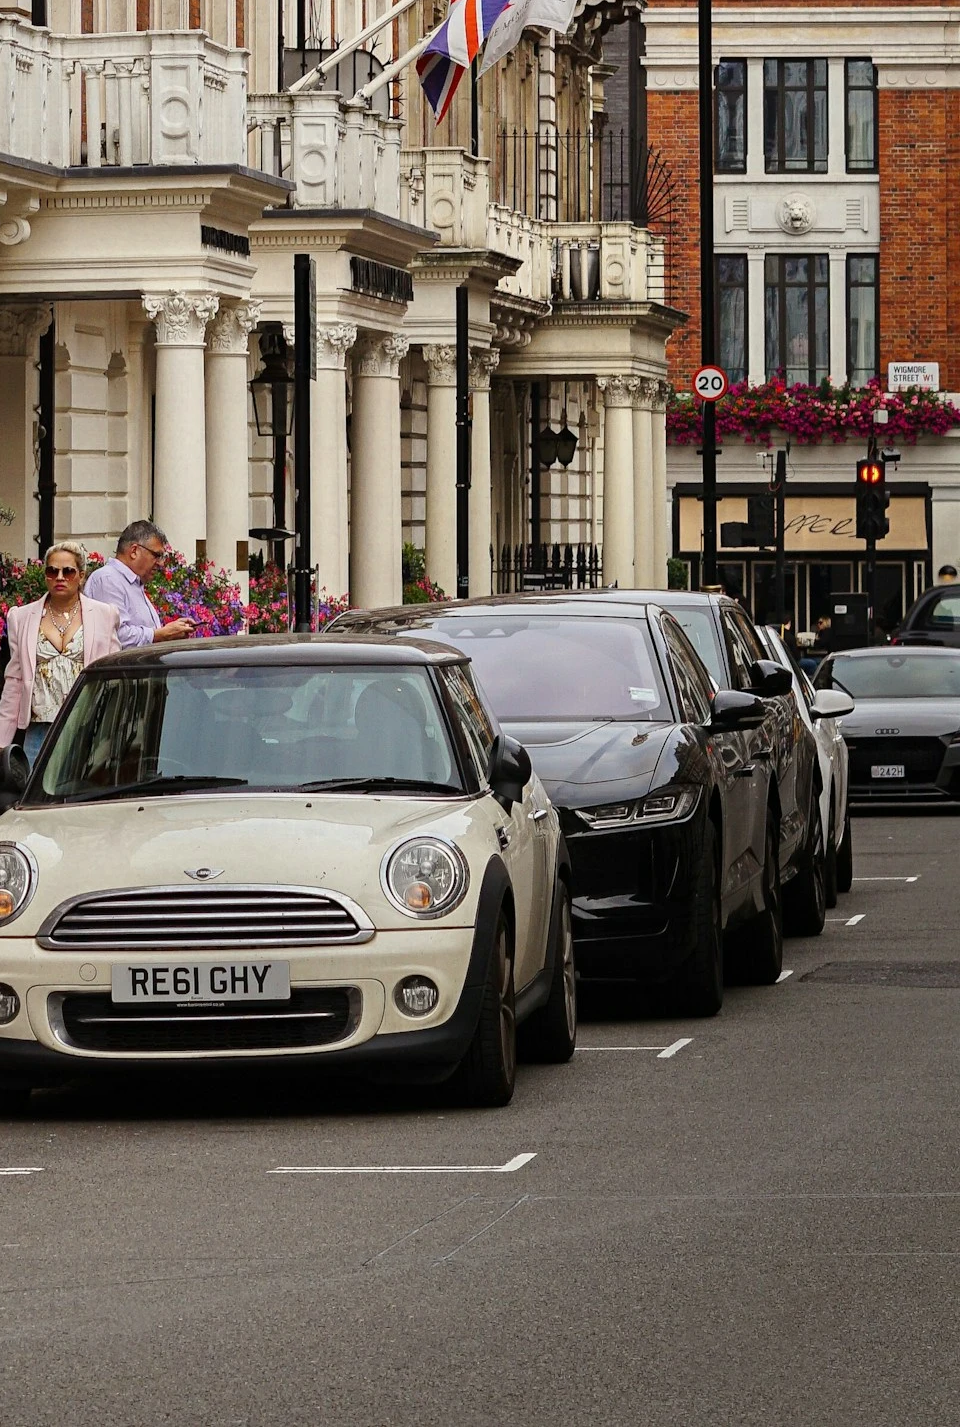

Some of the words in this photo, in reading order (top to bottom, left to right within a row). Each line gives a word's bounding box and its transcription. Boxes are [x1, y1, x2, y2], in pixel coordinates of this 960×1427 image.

[893, 365, 927, 374] WIGMORE
[698, 376, 723, 391] 20
[893, 374, 919, 382] STREET
[922, 374, 934, 382] W1
[131, 967, 199, 996] RE61
[209, 965, 270, 994] GHY
